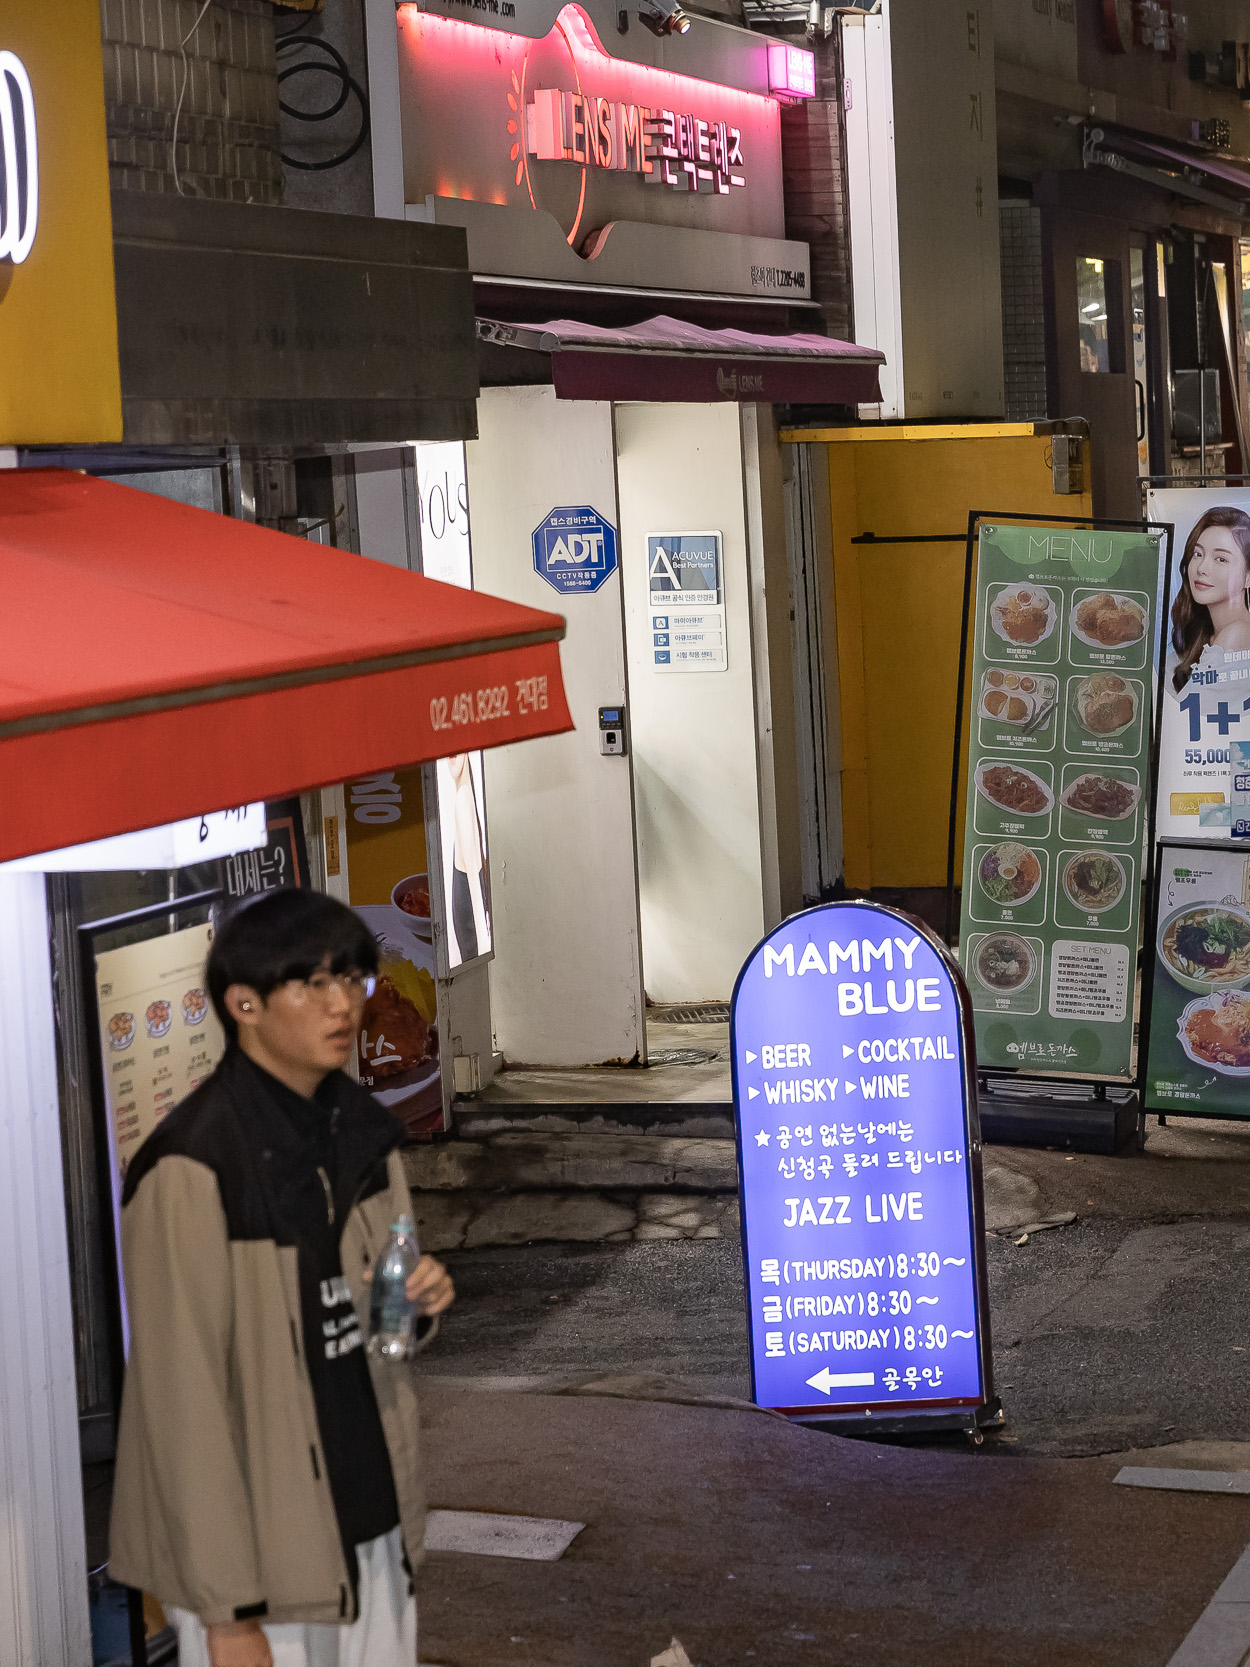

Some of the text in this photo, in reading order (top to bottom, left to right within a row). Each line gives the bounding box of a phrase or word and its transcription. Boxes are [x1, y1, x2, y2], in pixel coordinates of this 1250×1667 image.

[560, 89, 746, 196] LENS ME 콘택트렌즈
[549, 515, 597, 526] 캡스경비구역
[547, 532, 603, 566] ADT
[672, 550, 714, 561] ACUVUE
[672, 561, 714, 569] Best Partners
[1028, 535, 1113, 564] MENU
[1191, 664, 1229, 686] 악마로
[515, 675, 549, 715] 건대점
[225, 845, 285, 898] 대세는?
[763, 937, 921, 978] MAMMY
[1070, 944, 1112, 955] SET MENU
[837, 977, 942, 1017] BLUE
[761, 1035, 956, 1070] BEER COCKTAIL
[763, 1073, 911, 1105] WHISKY WINE
[776, 1118, 915, 1150] 공연 없는날에는
[777, 1149, 963, 1181] 신청곡 들려 드립니다
[783, 1191, 924, 1228] JAZZ LIVE
[881, 1364, 944, 1393] 골목안
